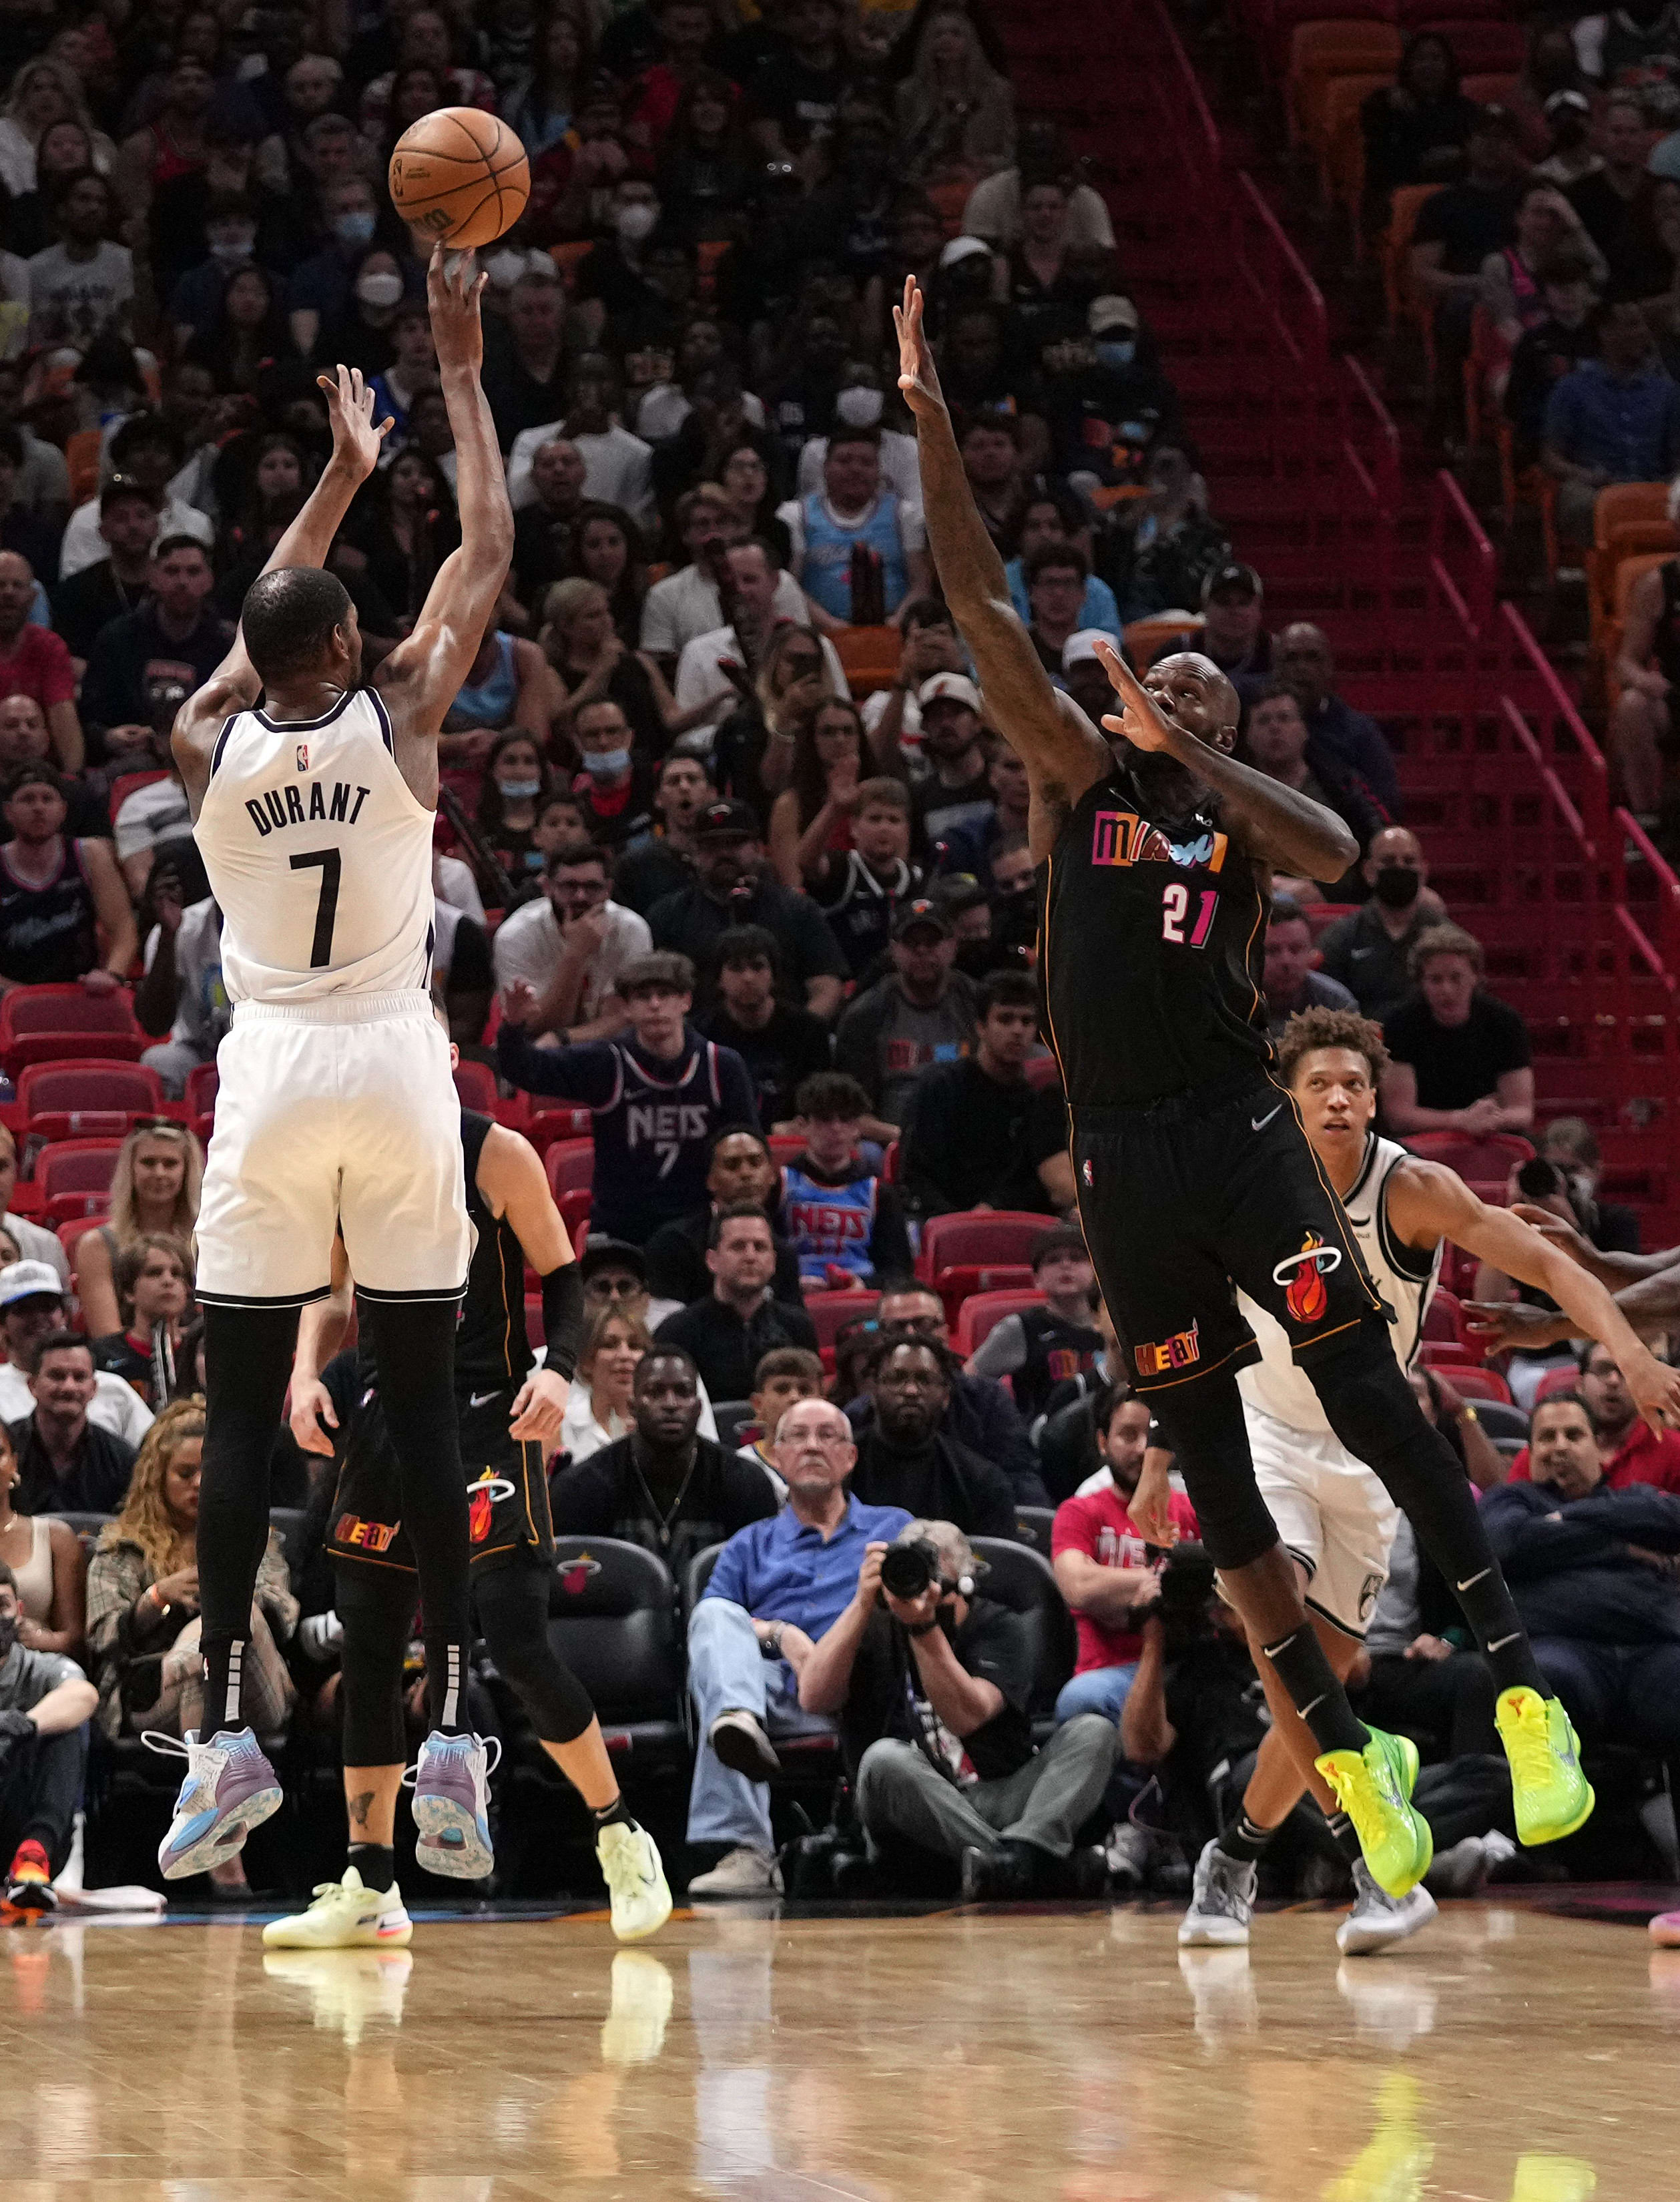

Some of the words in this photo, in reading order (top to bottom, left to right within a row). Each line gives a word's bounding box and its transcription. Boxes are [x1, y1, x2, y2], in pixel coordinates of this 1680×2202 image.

[245, 782, 370, 836] DURANT
[289, 847, 341, 968] 7
[1162, 882, 1219, 949] 21
[627, 1103, 710, 1148] NETS
[653, 1141, 680, 1179] 7
[792, 1205, 868, 1239] NETS
